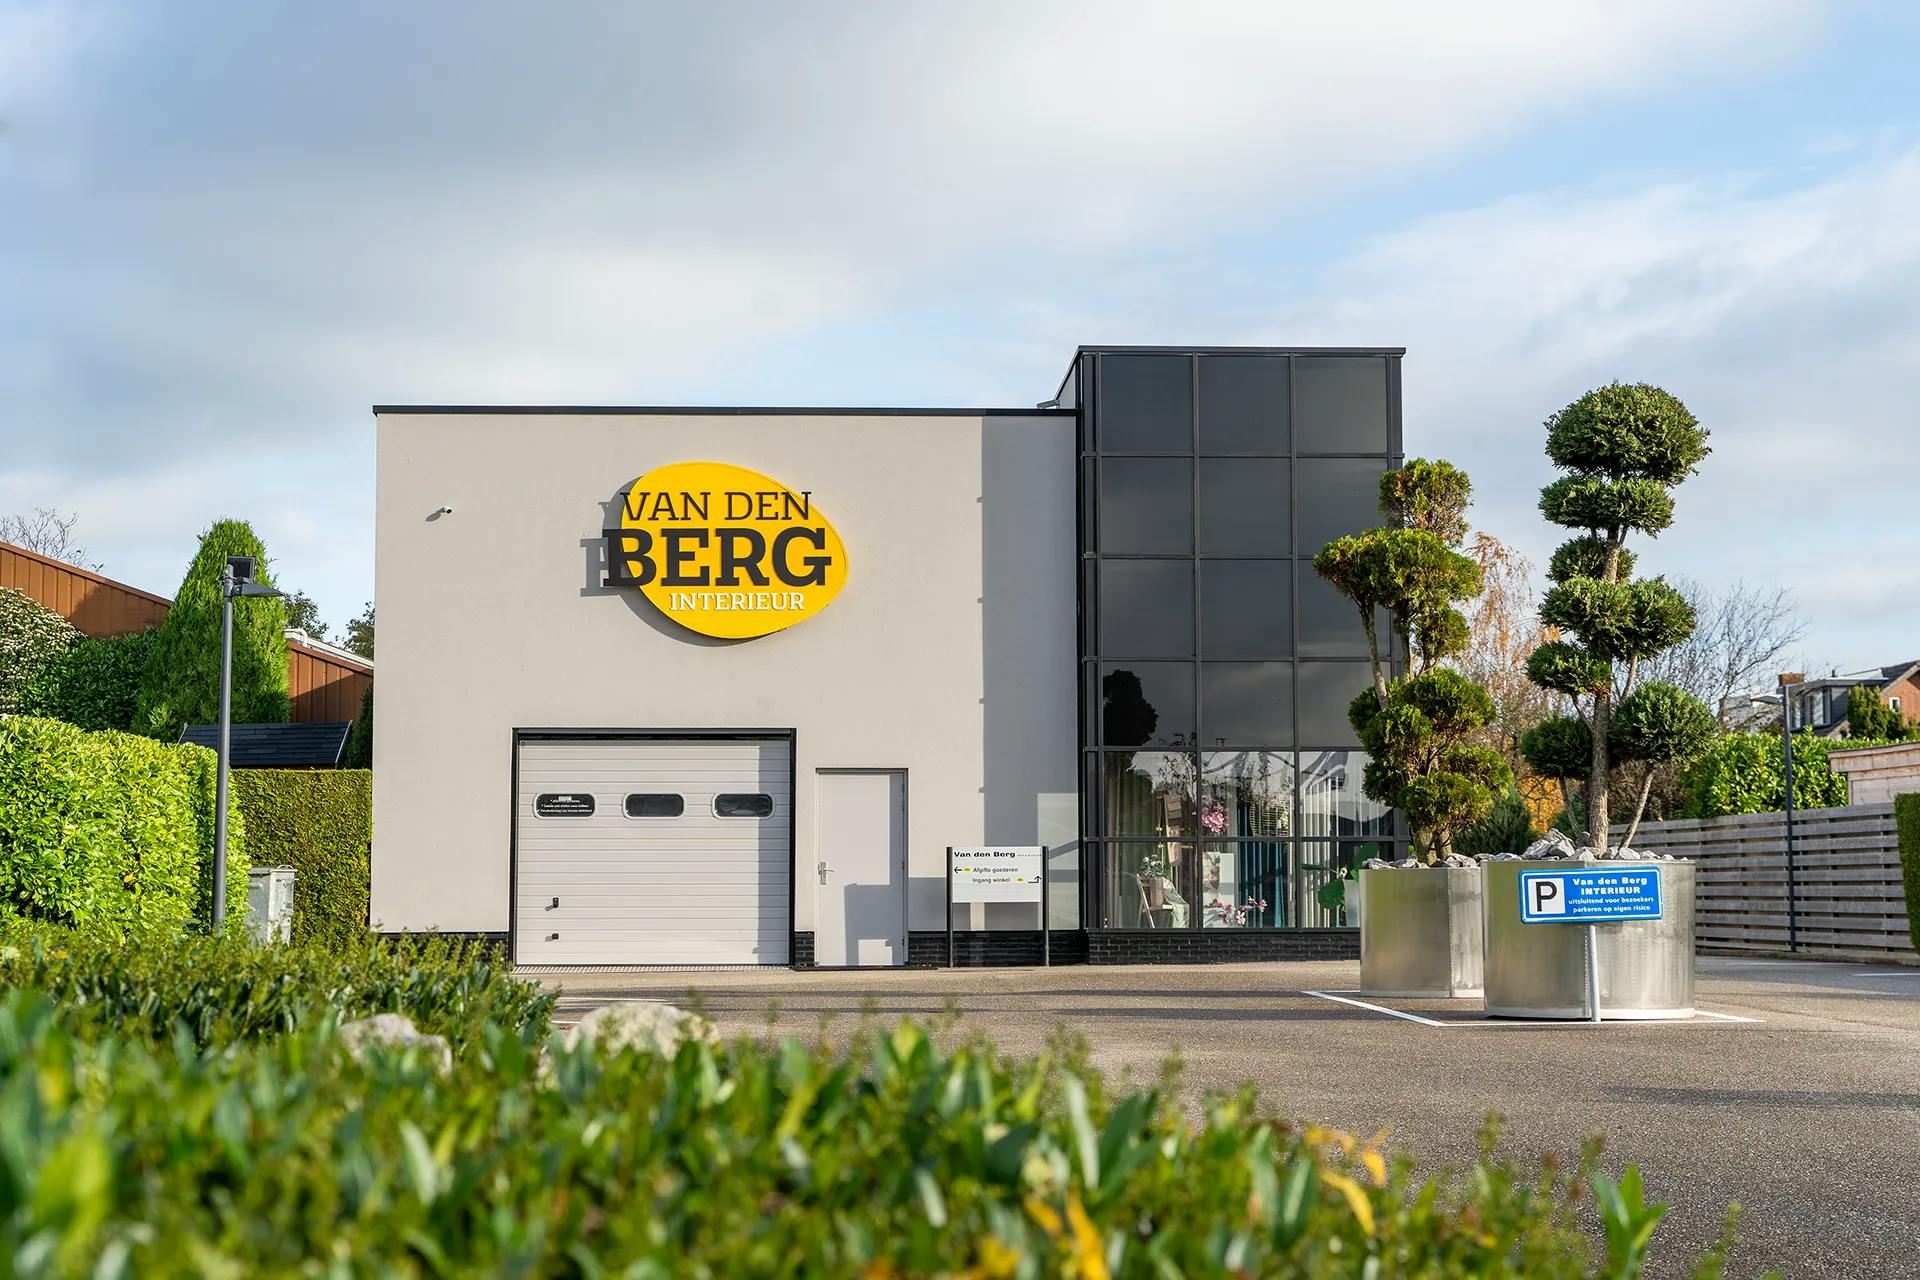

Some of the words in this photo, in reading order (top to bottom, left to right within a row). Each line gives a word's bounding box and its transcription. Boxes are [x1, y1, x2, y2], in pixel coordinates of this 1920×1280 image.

[619, 491, 711, 521] VAN
[724, 491, 812, 521] DEN
[602, 526, 832, 587] BERG
[669, 592, 805, 611] INTERIEUR
[1572, 878, 1594, 886] Van
[1598, 877, 1618, 885] den
[1621, 877, 1648, 885] Berg
[1580, 886, 1641, 895] INTERIEUR
[1535, 881, 1558, 912] P
